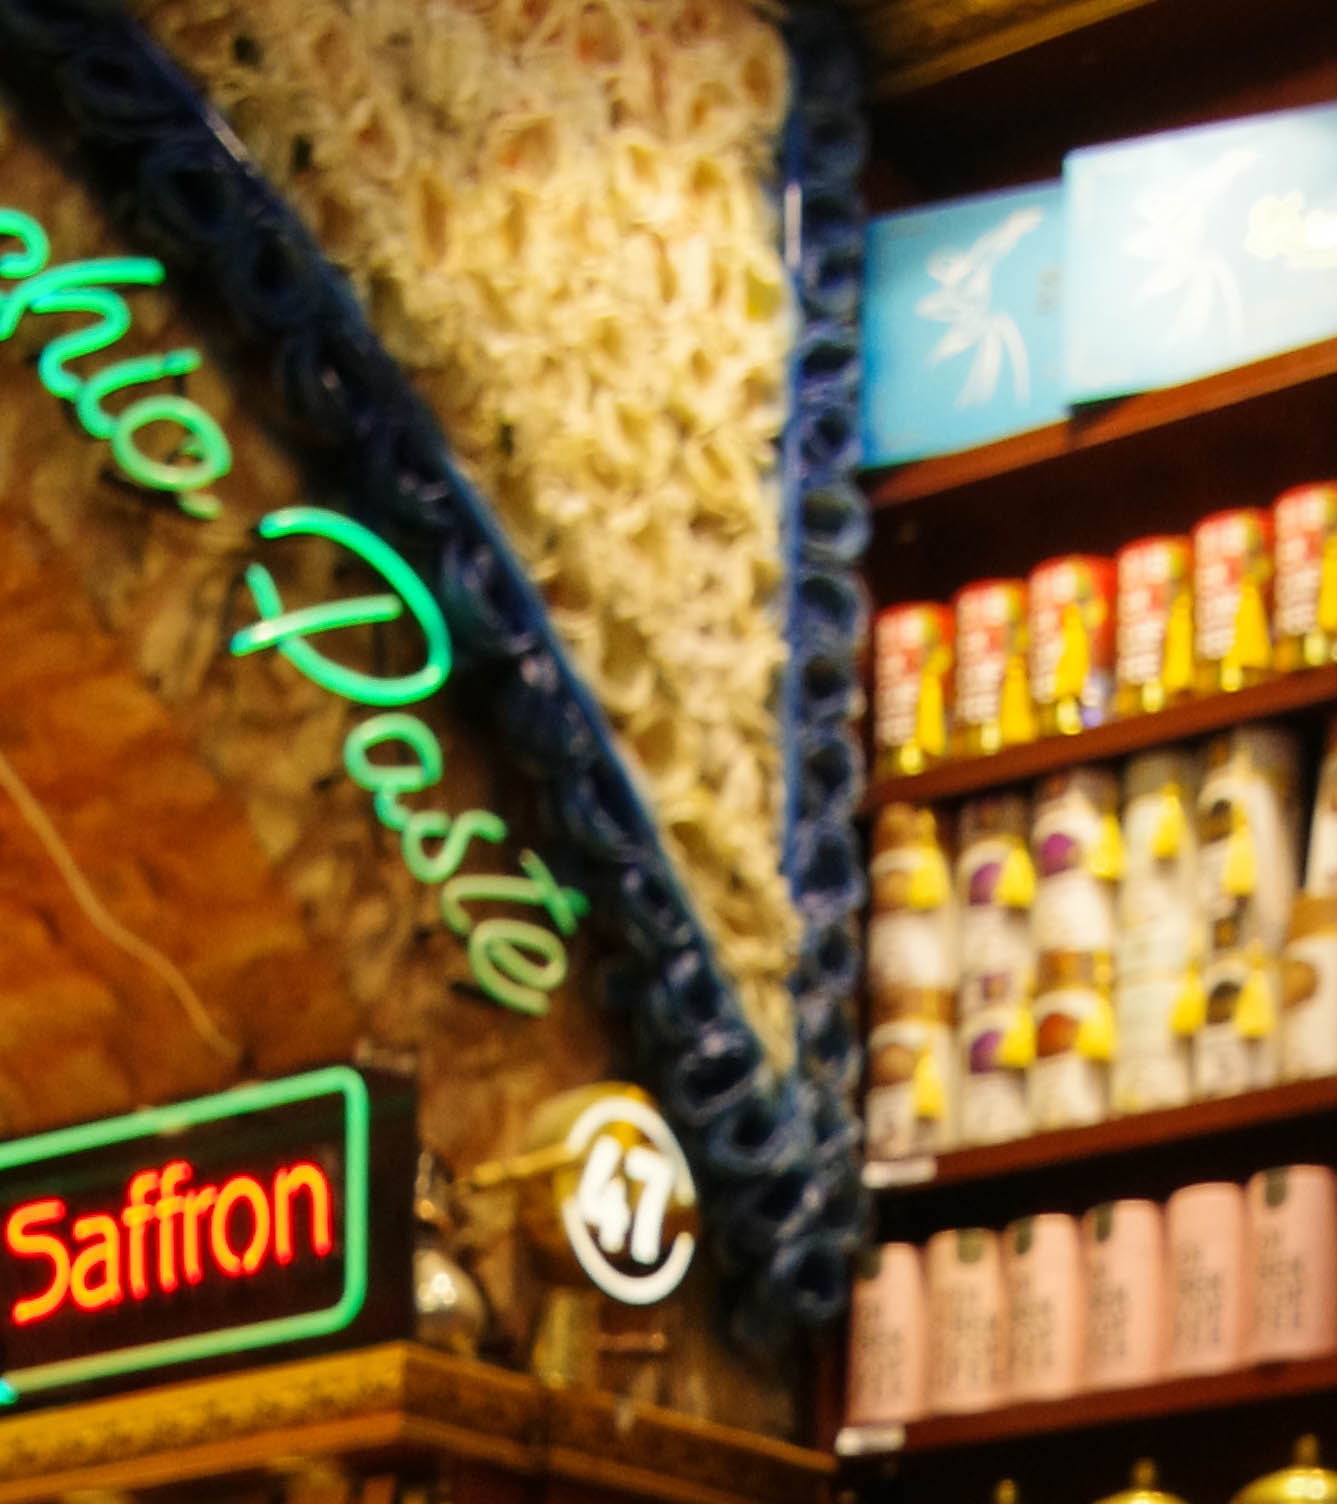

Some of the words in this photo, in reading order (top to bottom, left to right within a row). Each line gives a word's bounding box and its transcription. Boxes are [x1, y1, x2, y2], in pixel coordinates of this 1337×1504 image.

[230, 507, 589, 1017] Paste
[6, 1160, 333, 1326] Saffron
[578, 1134, 677, 1267] 47
